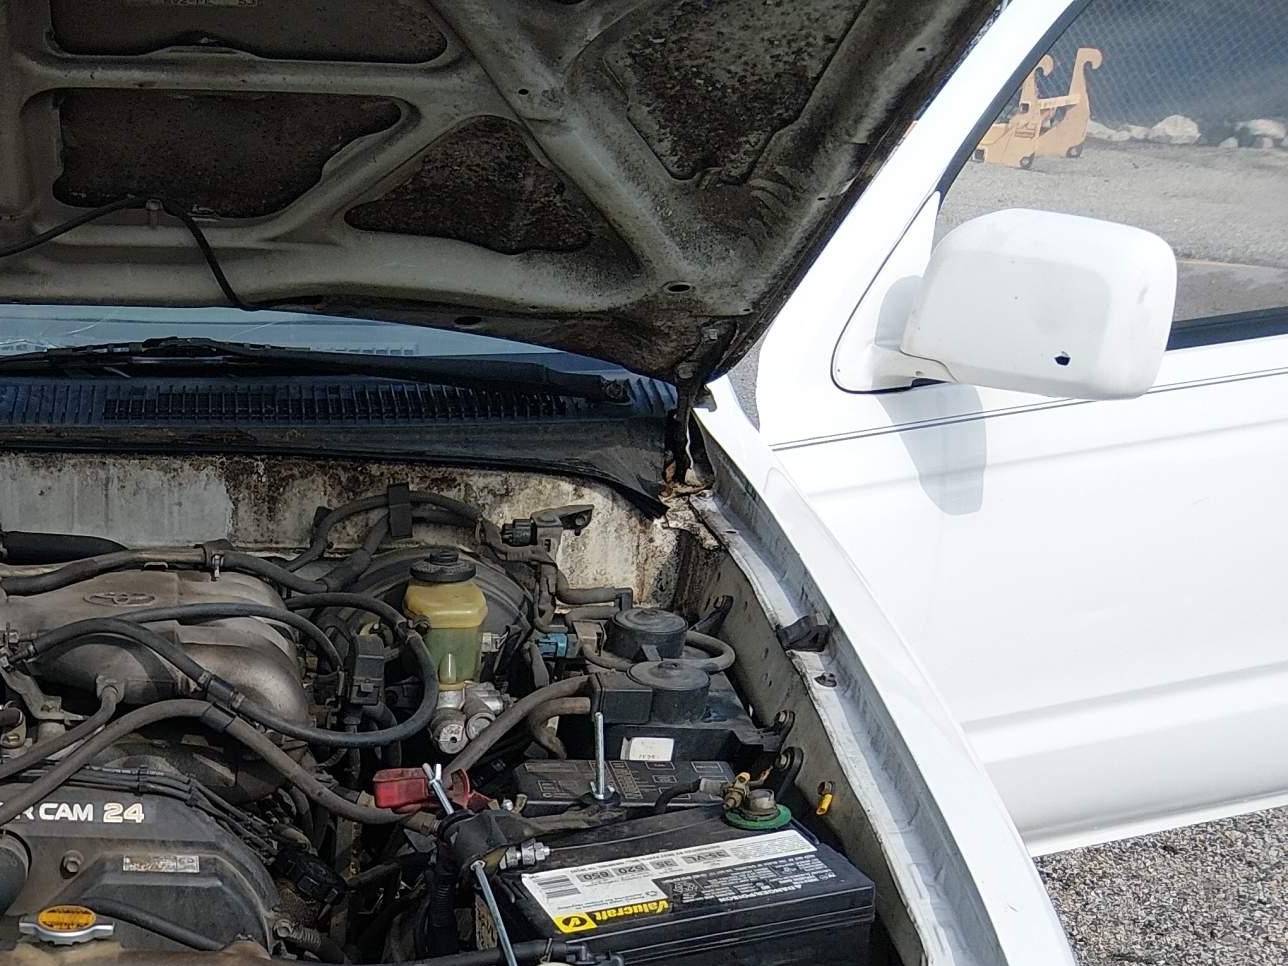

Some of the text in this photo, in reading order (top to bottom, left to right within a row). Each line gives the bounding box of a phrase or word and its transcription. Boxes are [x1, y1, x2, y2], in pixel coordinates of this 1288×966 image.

[38, 802, 94, 822] CAM
[102, 802, 145, 824] 24
[582, 871, 609, 881] 650
[618, 863, 646, 874] 520
[594, 900, 670, 921] Valucraft
